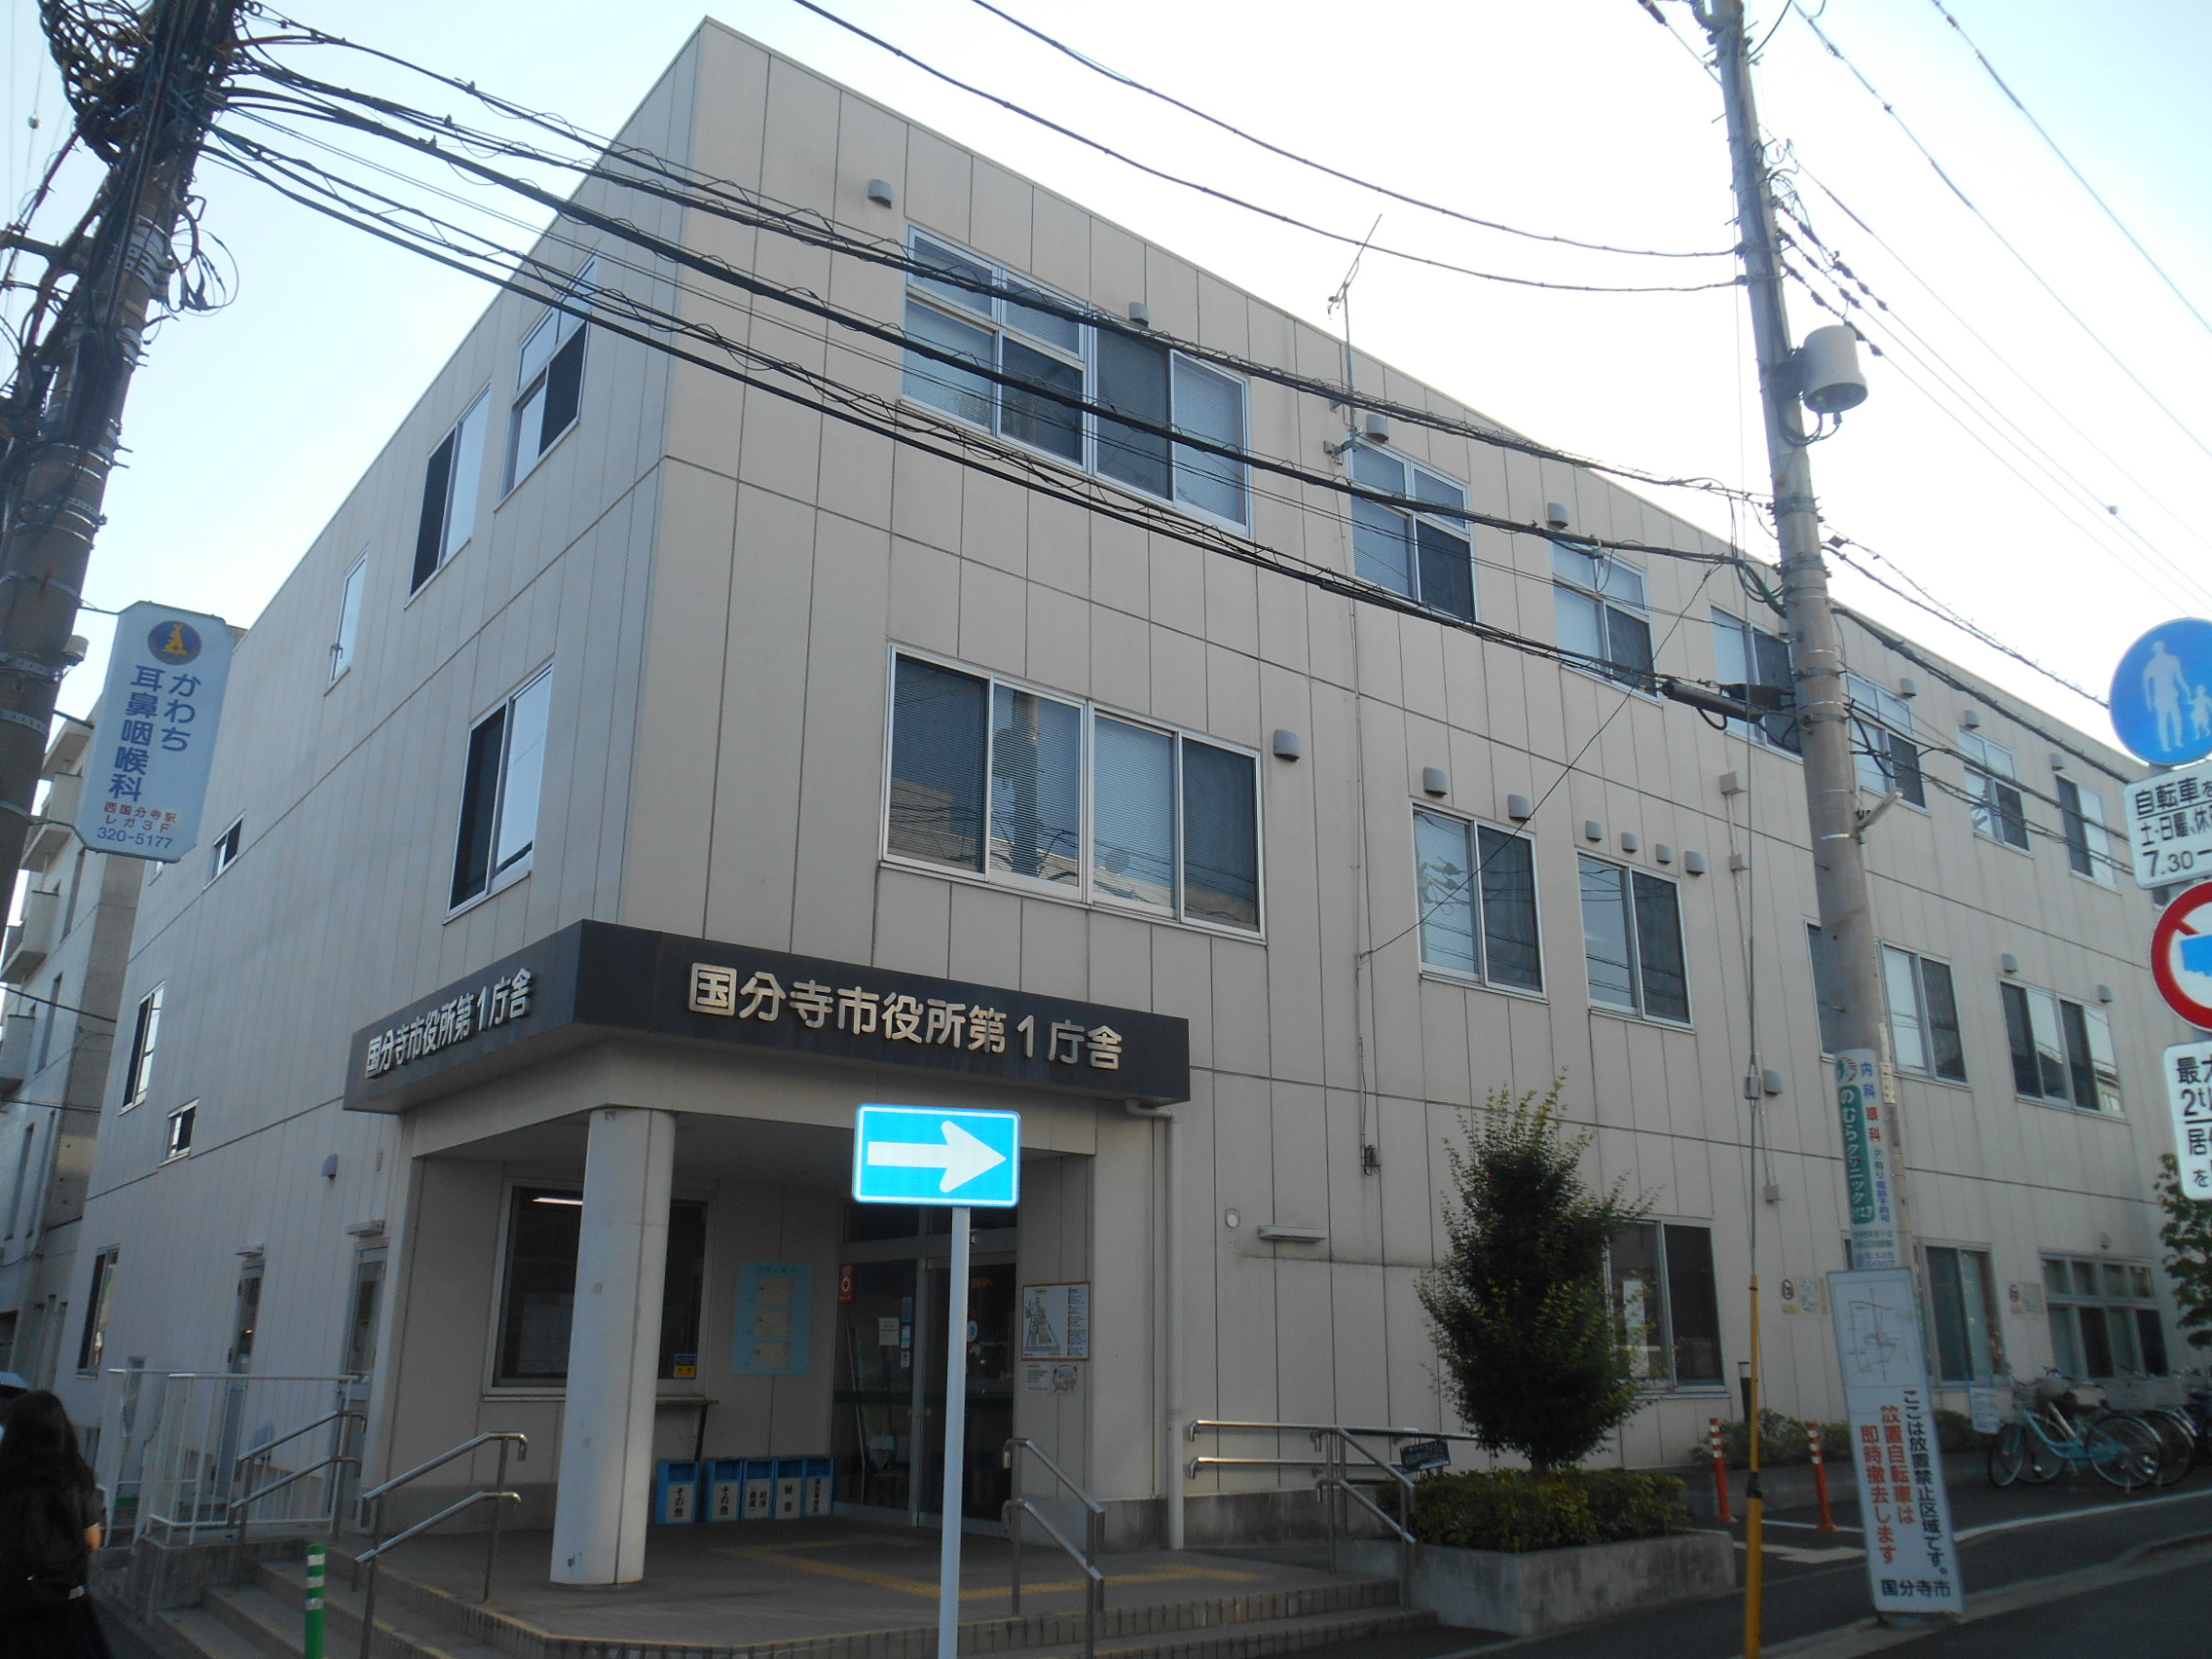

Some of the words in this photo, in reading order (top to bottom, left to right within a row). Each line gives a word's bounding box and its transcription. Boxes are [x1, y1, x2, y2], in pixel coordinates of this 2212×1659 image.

[161, 673, 201, 752] かわち
[108, 665, 166, 803] 耳鼻咽喉科
[104, 801, 177, 824] 西国分寺駅
[2140, 805, 2212, 846] 土・日曜、休
[97, 827, 173, 850] 320-5177
[365, 968, 532, 1080] 国分寺市役所第1庁舎
[688, 961, 1123, 1070] 国分寺市役所第1庁舎
[2181, 1086, 2212, 1117] 2t
[2188, 1126, 2212, 1156] 居
[1880, 1404, 1917, 1525] 放置自転車は
[1903, 1389, 1948, 1574] ここは放置禁止区域です。
[674, 1487, 684, 1518] その他
[719, 1486, 730, 1515] その他
[1860, 1425, 1898, 1564] 即時撤去します
[1881, 1579, 1951, 1599] 国分寺市
